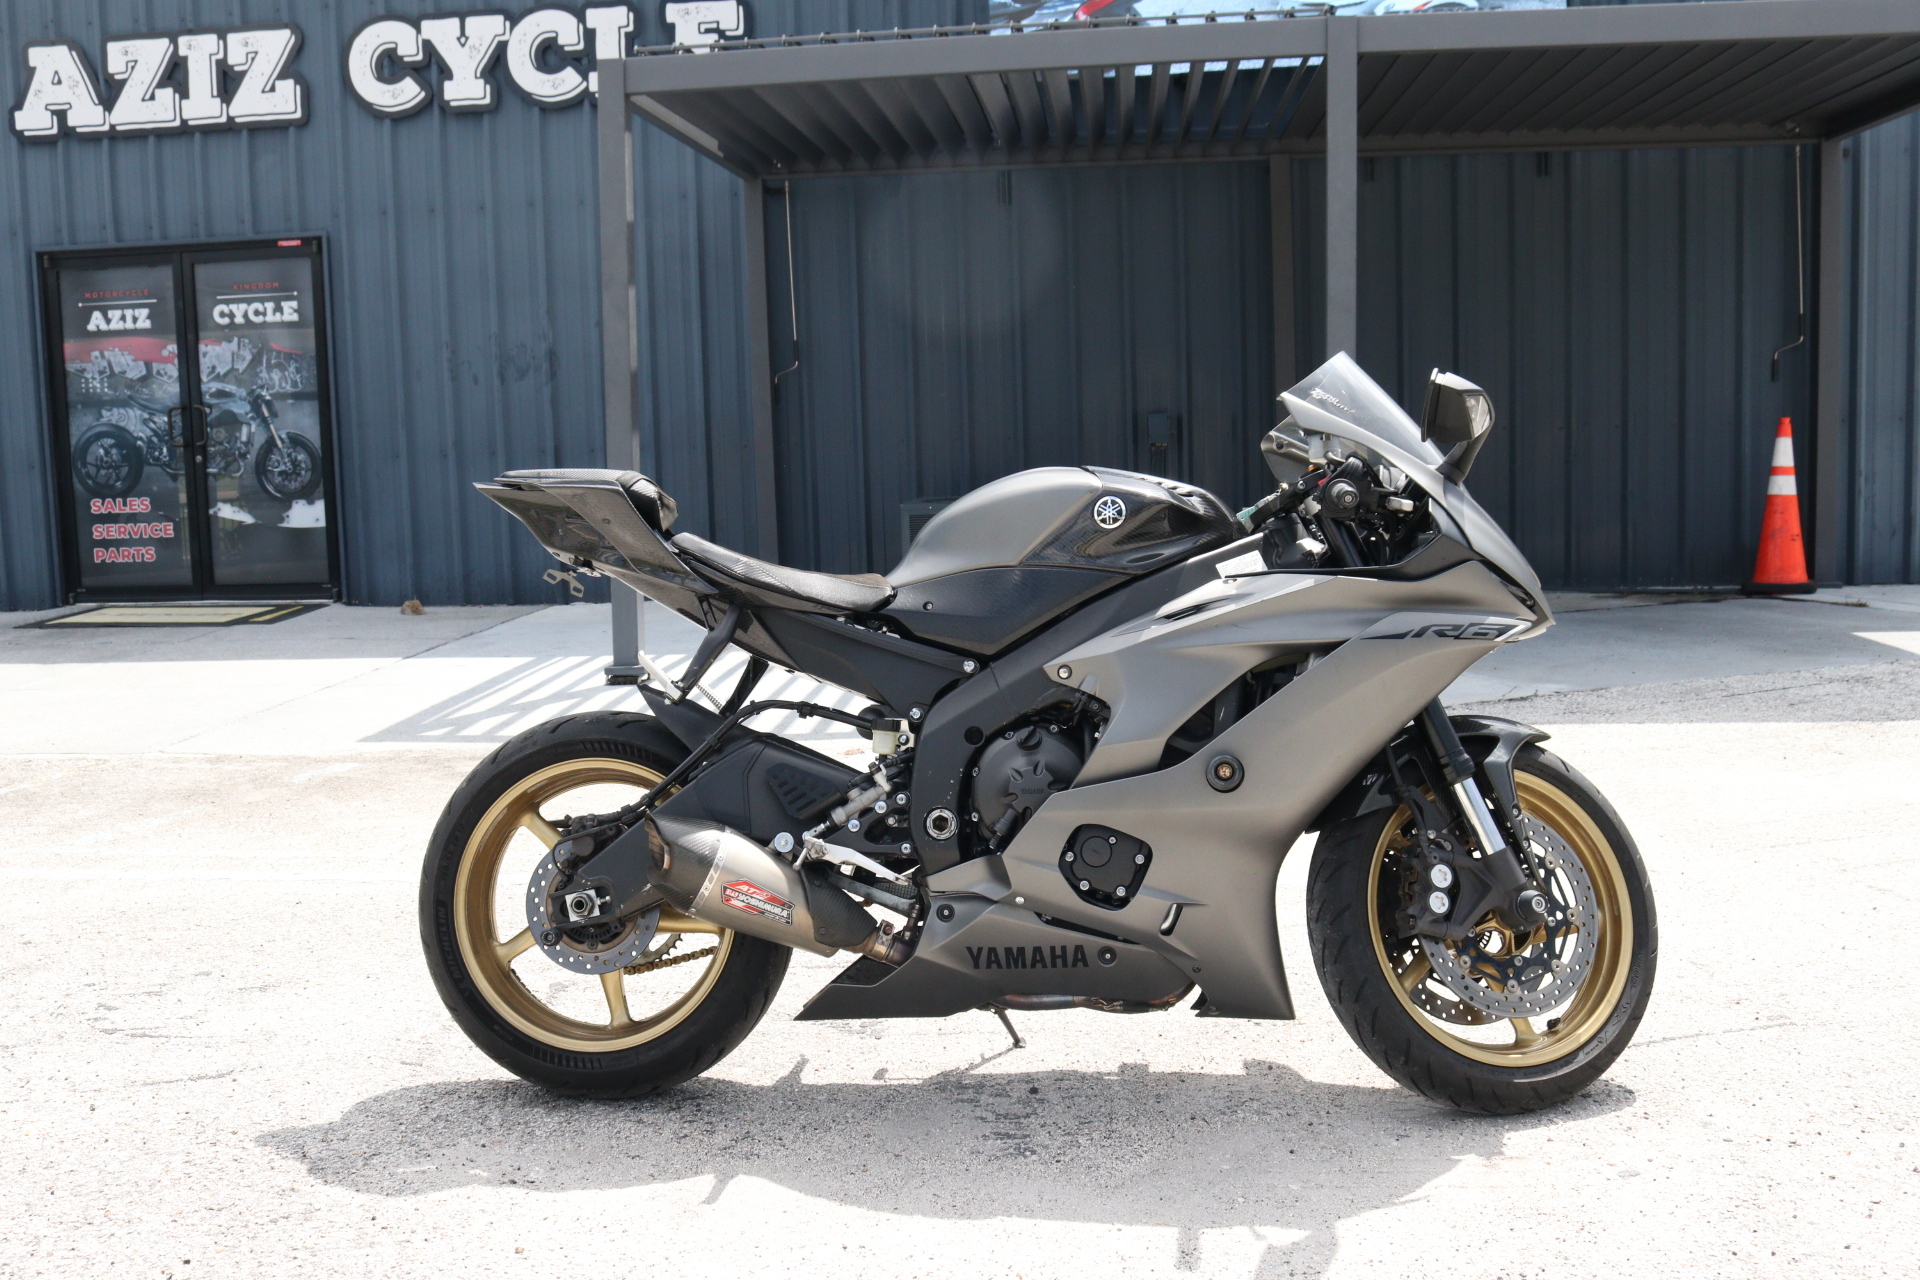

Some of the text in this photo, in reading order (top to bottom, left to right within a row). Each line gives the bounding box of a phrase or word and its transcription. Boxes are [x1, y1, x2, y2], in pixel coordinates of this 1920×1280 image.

[14, 28, 302, 137] AZIZ
[84, 282, 279, 299] MOTORCYCLE KINGDOM
[87, 301, 299, 331] AZIZ CYCLE
[91, 497, 151, 514] SALES
[92, 522, 174, 539] SERVICE
[94, 547, 156, 563] PARTS
[1410, 623, 1511, 640] R6
[437, 906, 462, 979] MICHELIN
[966, 945, 1089, 969] YAMAHA
